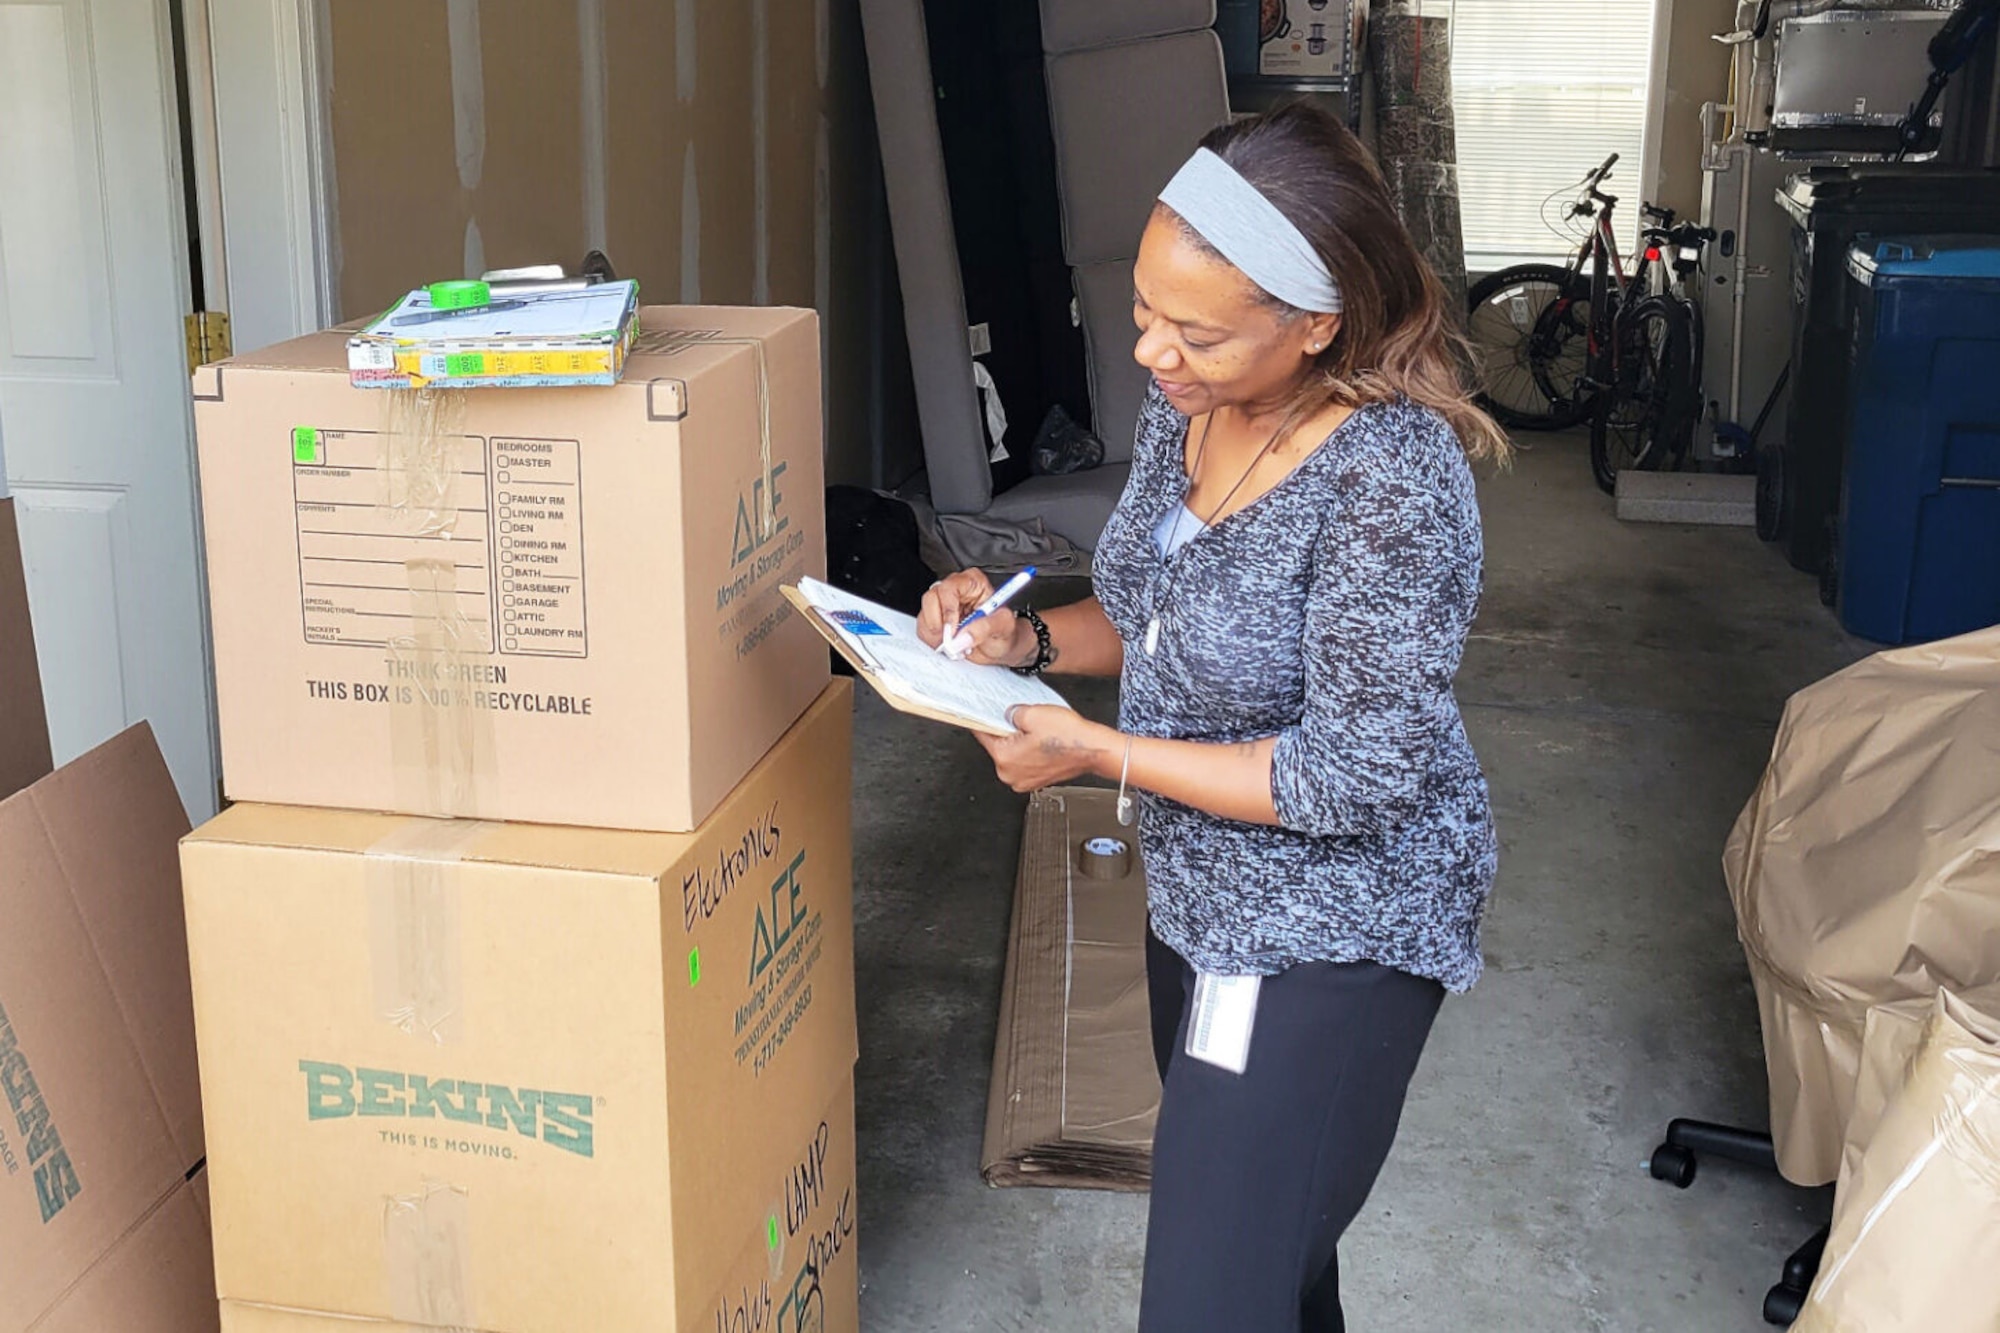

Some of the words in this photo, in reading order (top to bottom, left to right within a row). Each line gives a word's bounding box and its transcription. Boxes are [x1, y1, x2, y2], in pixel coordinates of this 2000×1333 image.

[497, 443, 552, 453] BEDROOMS
[511, 458, 551, 467] MASTER
[296, 468, 320, 476] ORDER
[512, 495, 547, 504] FAMILY
[549, 496, 565, 505] RM
[512, 510, 545, 519] LIVING
[548, 511, 564, 520] RM
[513, 524, 534, 533] DEN
[513, 540, 548, 549] DINING
[550, 541, 566, 550] RM
[514, 554, 558, 563] KITCHEN
[515, 568, 541, 577] BATH
[717, 574, 748, 612] Moving
[757, 544, 786, 579] Storage
[515, 584, 571, 594] BASEMENT
[305, 598, 334, 606] SPECIAL
[516, 598, 559, 608] GARAGE
[305, 606, 356, 614] INSTRUCTIONS
[517, 613, 545, 622] ATTIC
[307, 626, 341, 634] PACKER'S
[517, 627, 565, 637] LAUNDRY
[567, 630, 583, 639] RM
[384, 659, 440, 680] THINK
[446, 663, 506, 683] GREEN
[307, 680, 347, 700] THIS
[354, 684, 389, 702] BOX
[396, 686, 412, 704] IS
[474, 690, 592, 715] RECYCLABLE
[683, 801, 780, 933] Electronics
[749, 848, 807, 987] ACE
[734, 984, 766, 1037] Moving
[768, 969, 774, 995] &
[776, 935, 805, 984] Storage
[299, 1059, 595, 1159] BEKINS
[379, 1131, 417, 1146] THIS
[423, 1135, 439, 1149] IS
[445, 1140, 518, 1160] MOVING.
[786, 1121, 828, 1237] LAMP
